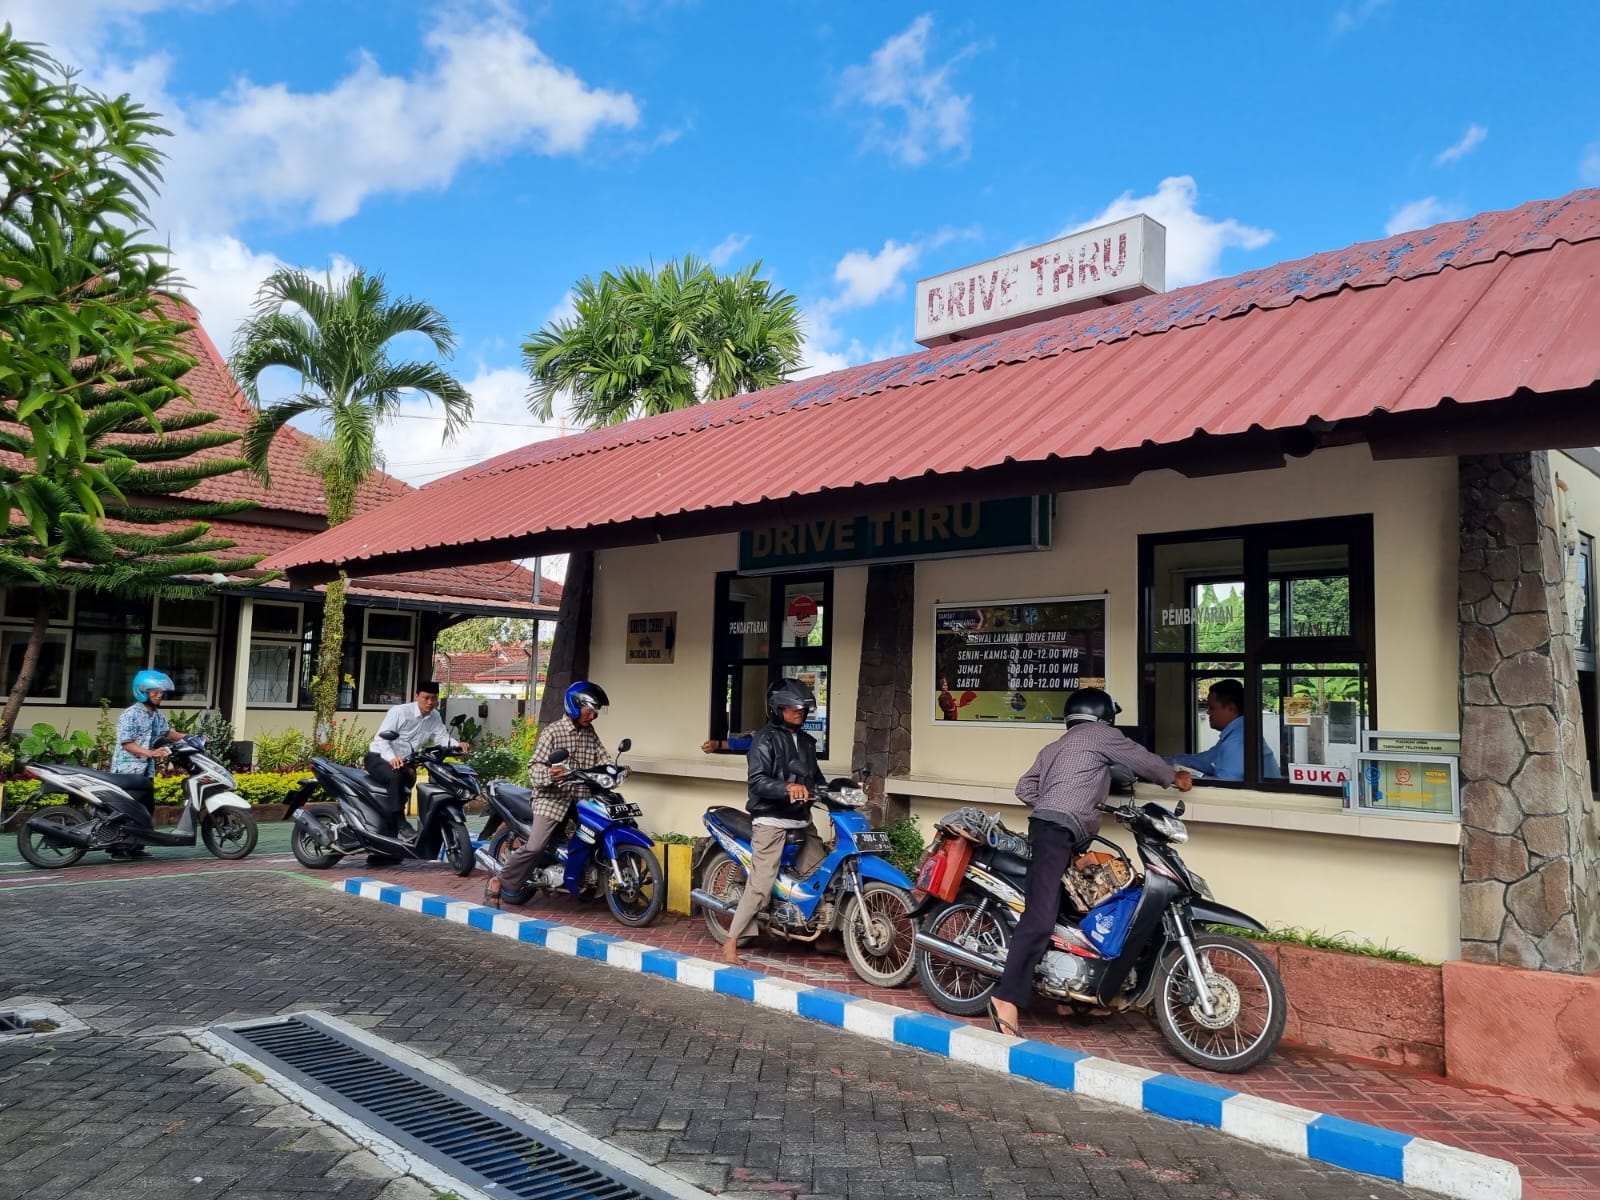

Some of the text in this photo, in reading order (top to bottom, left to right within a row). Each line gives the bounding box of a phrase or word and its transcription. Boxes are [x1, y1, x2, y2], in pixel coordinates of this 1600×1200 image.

[928, 233, 1127, 325] DRIVE THRU
[752, 501, 981, 558] DRIVE THRU
[1162, 606, 1234, 626] PEMBAYARAN
[730, 620, 768, 635] PENDAFTARAN
[993, 633, 1023, 643] LAYANAN
[1025, 632, 1046, 642] DRIVE
[1047, 631, 1066, 642] THRU
[1062, 648, 1079, 659] WIB
[957, 664, 983, 675] JUMAT
[1062, 663, 1079, 674] WIB
[956, 678, 981, 688] SABTU
[1063, 678, 1080, 688] WIB
[1293, 769, 1347, 784] BUKA
